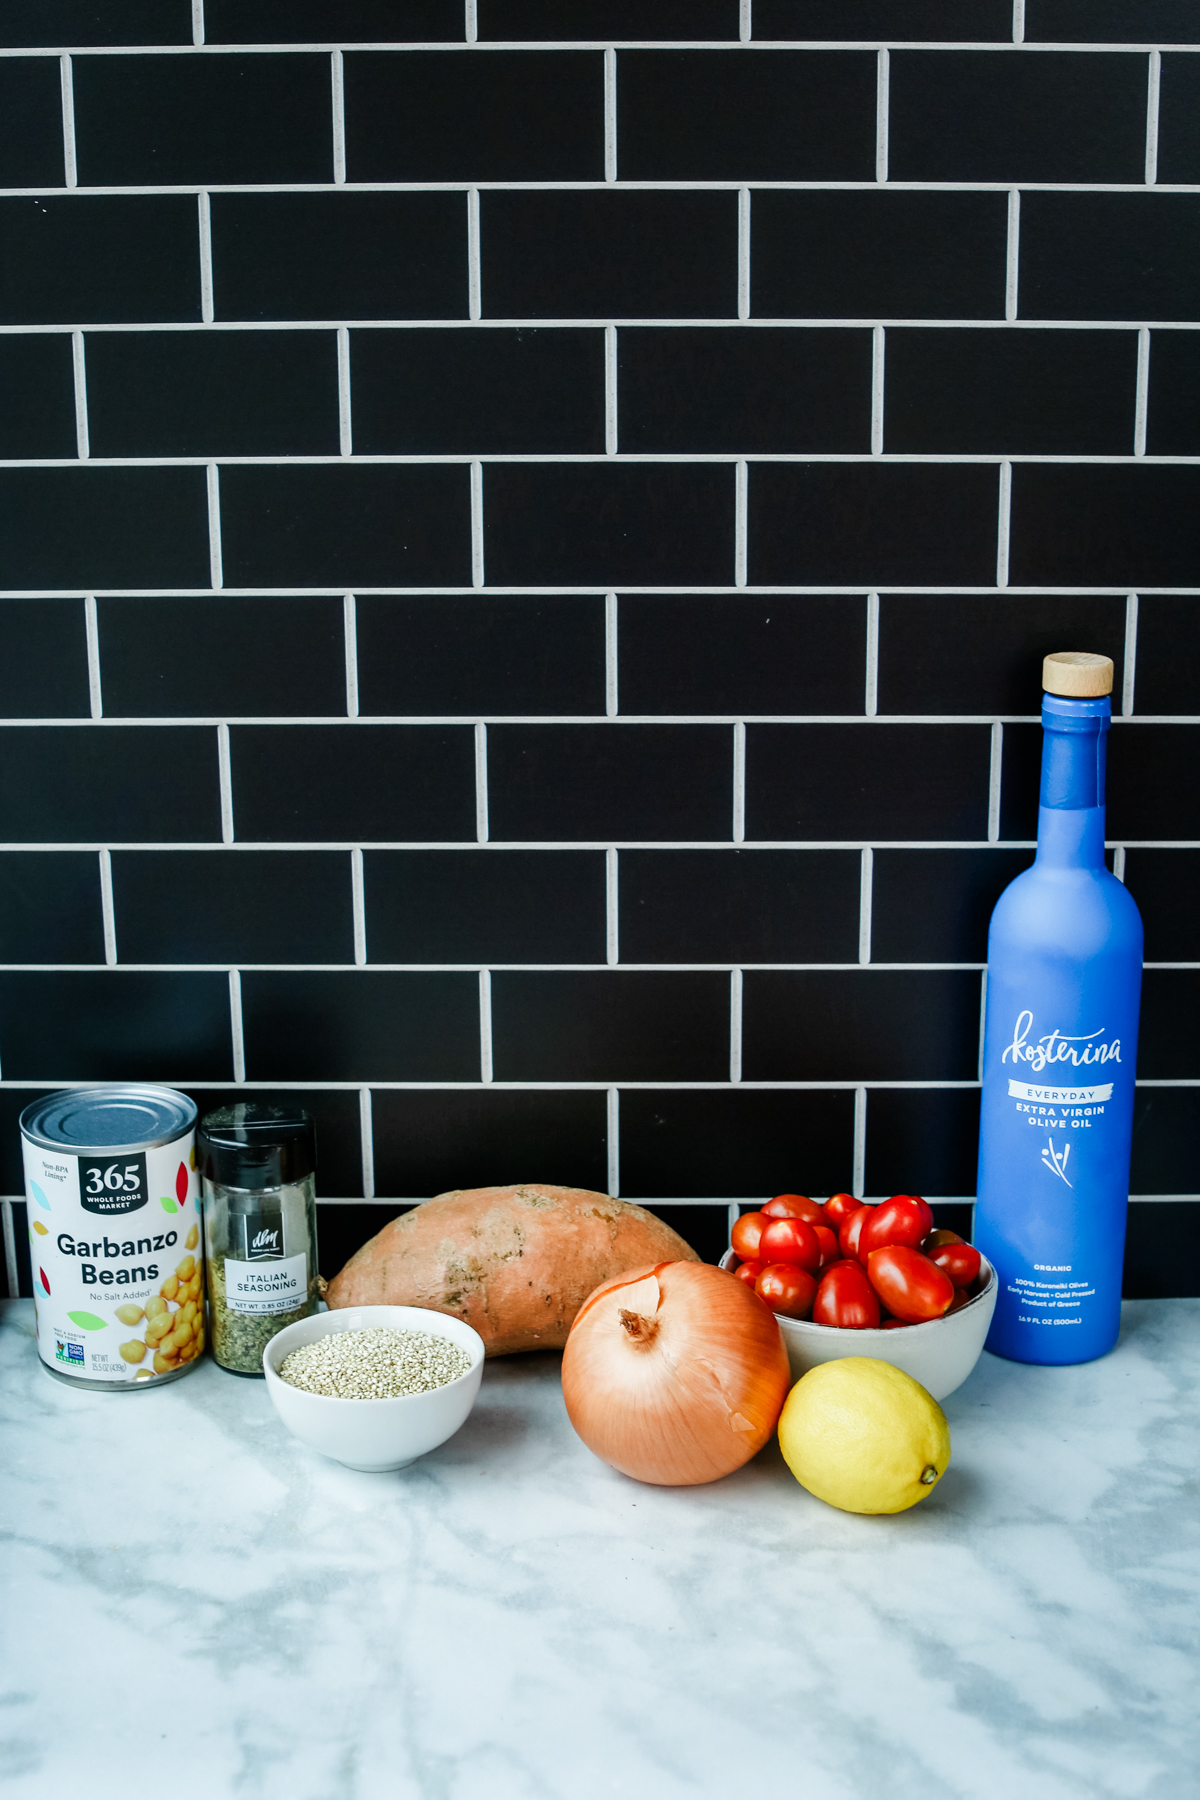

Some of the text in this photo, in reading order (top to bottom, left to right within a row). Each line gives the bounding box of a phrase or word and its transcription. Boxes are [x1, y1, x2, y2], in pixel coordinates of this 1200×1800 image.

[1002, 1010, 1122, 1072] kosterina
[1027, 1088, 1095, 1100] EVERYDAY
[1016, 1102, 1105, 1117] EXTRA VIRGIN
[1028, 1117, 1092, 1128] OLIVE OIL
[42, 1161, 69, 1174] Non-BPA
[85, 1163, 141, 1194] 365
[116, 1193, 142, 1202] FOODS
[99, 1202, 131, 1210] MARKET
[57, 1230, 178, 1258] Garbanzo
[1033, 1264, 1072, 1272] ORGANIC
[81, 1263, 159, 1285] Beans
[246, 1272, 288, 1283] ITALIAN
[237, 1279, 297, 1292] SEASONING
[1015, 1278, 1035, 1288] 100%
[90, 1293, 103, 1301] No
[104, 1293, 121, 1301] Salt
[1007, 1285, 1023, 1295] Early
[1023, 1290, 1050, 1298] Harvest
[1071, 1288, 1096, 1298] Pressed
[276, 1300, 286, 1308] OZ
[1021, 1298, 1048, 1307] Product
[1032, 1317, 1041, 1325] FL
[1053, 1317, 1082, 1326] (500mL)
[68, 1343, 83, 1351] NON
[56, 1354, 85, 1366] VERIFIED
[100, 1354, 108, 1363] WT
[92, 1362, 103, 1371] 15.5
[103, 1363, 110, 1372] OZ
[109, 1363, 127, 1373] (439g)
